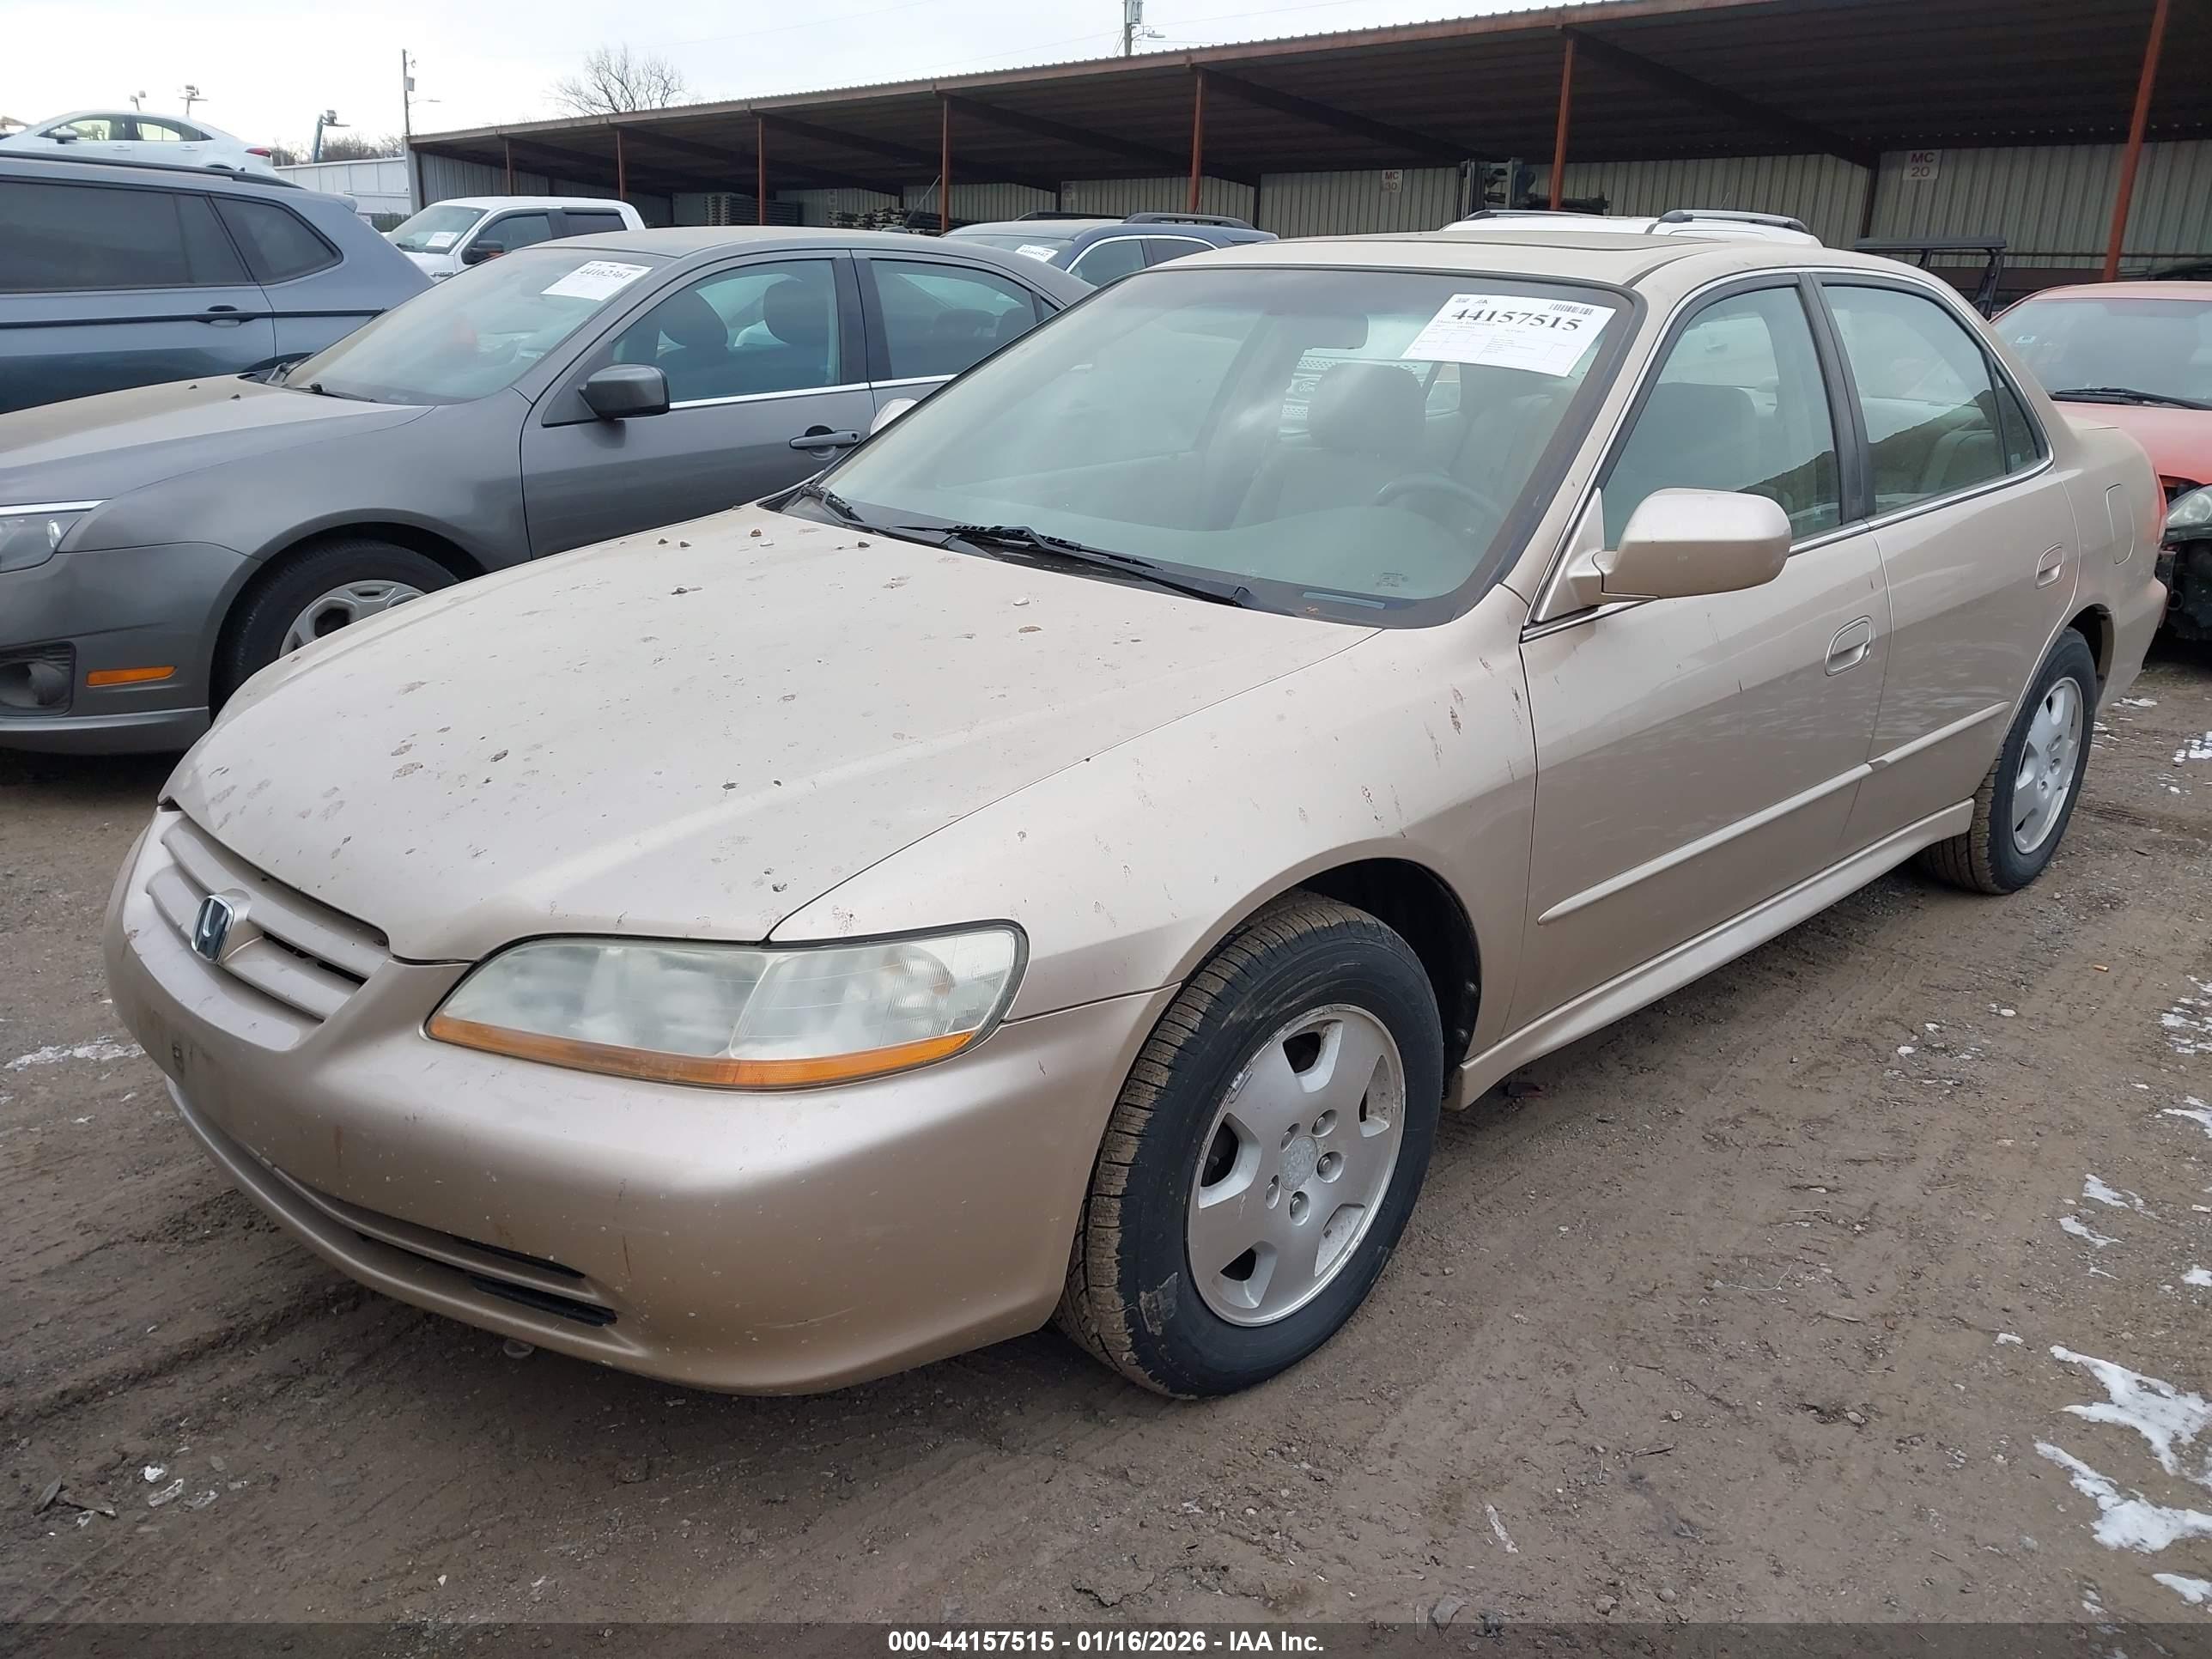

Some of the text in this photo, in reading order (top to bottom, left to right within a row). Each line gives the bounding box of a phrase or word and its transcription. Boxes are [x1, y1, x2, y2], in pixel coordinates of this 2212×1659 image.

[1911, 151, 1936, 163] MC
[1384, 171, 1400, 179] MC
[1911, 166, 1930, 177] 20
[1451, 307, 1583, 331] 44157515
